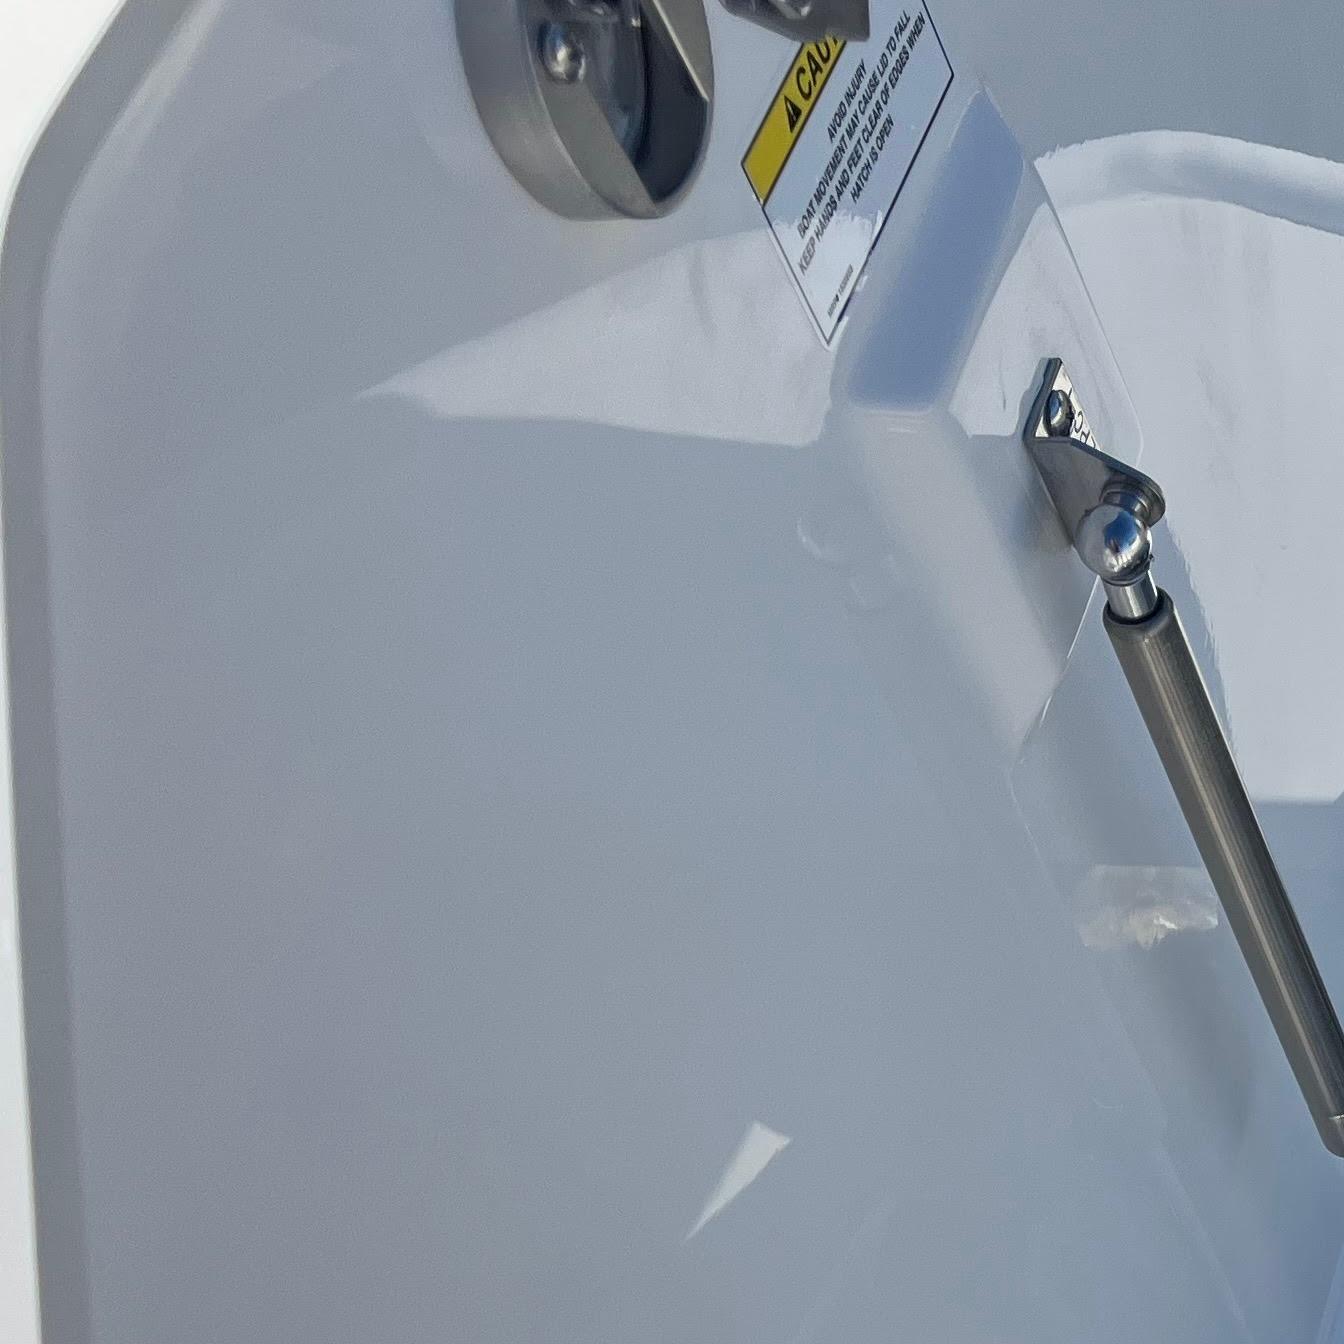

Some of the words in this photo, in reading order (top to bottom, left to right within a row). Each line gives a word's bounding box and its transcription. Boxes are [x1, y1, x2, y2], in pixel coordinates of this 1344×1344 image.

[797, 201, 817, 238] BOAT
[813, 135, 849, 207] MOVEMENT
[844, 110, 861, 141] MAY
[857, 71, 880, 116] CAUSE
[876, 53, 889, 76] LID
[885, 36, 897, 58] TO
[893, 11, 910, 42] FALL
[797, 237, 817, 275] KEEP
[813, 195, 838, 243] HANDS
[833, 168, 850, 201] AND
[846, 139, 865, 175] FEET
[861, 101, 883, 145] CLEAR
[879, 84, 891, 106] OF
[906, 13, 925, 51] WHEN
[825, 101, 847, 143] AVOID
[843, 60, 867, 107] INJURY
[850, 160, 872, 204] HATCH
[868, 147, 878, 165] IS
[874, 115, 894, 152] OPEN
